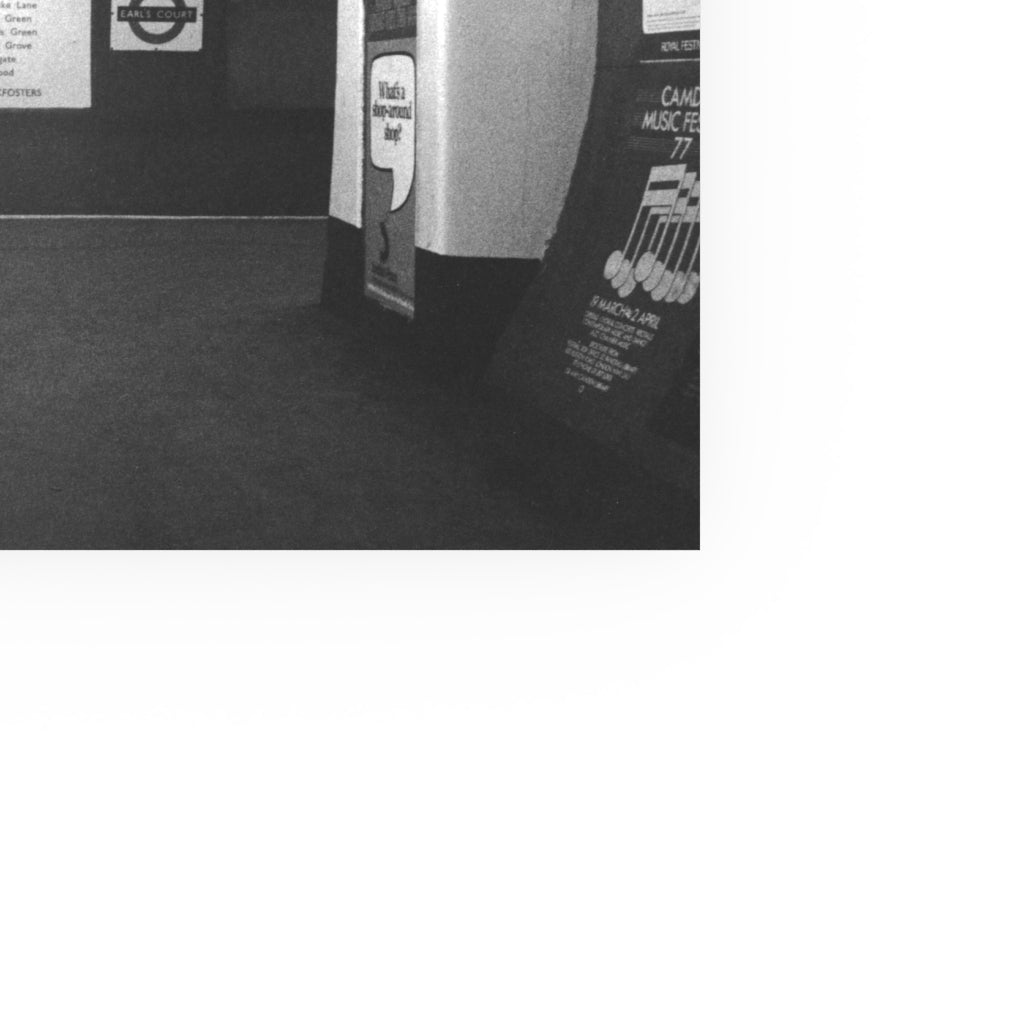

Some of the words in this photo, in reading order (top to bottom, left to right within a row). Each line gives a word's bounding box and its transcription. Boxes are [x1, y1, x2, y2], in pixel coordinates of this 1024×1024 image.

[16, 1, 38, 10] Lane
[5, 14, 33, 23] Green
[156, 10, 194, 20] COURT
[10, 27, 38, 36] Green
[5, 41, 33, 50] Grove
[641, 110, 682, 132] MUSIC
[670, 136, 694, 161] 77
